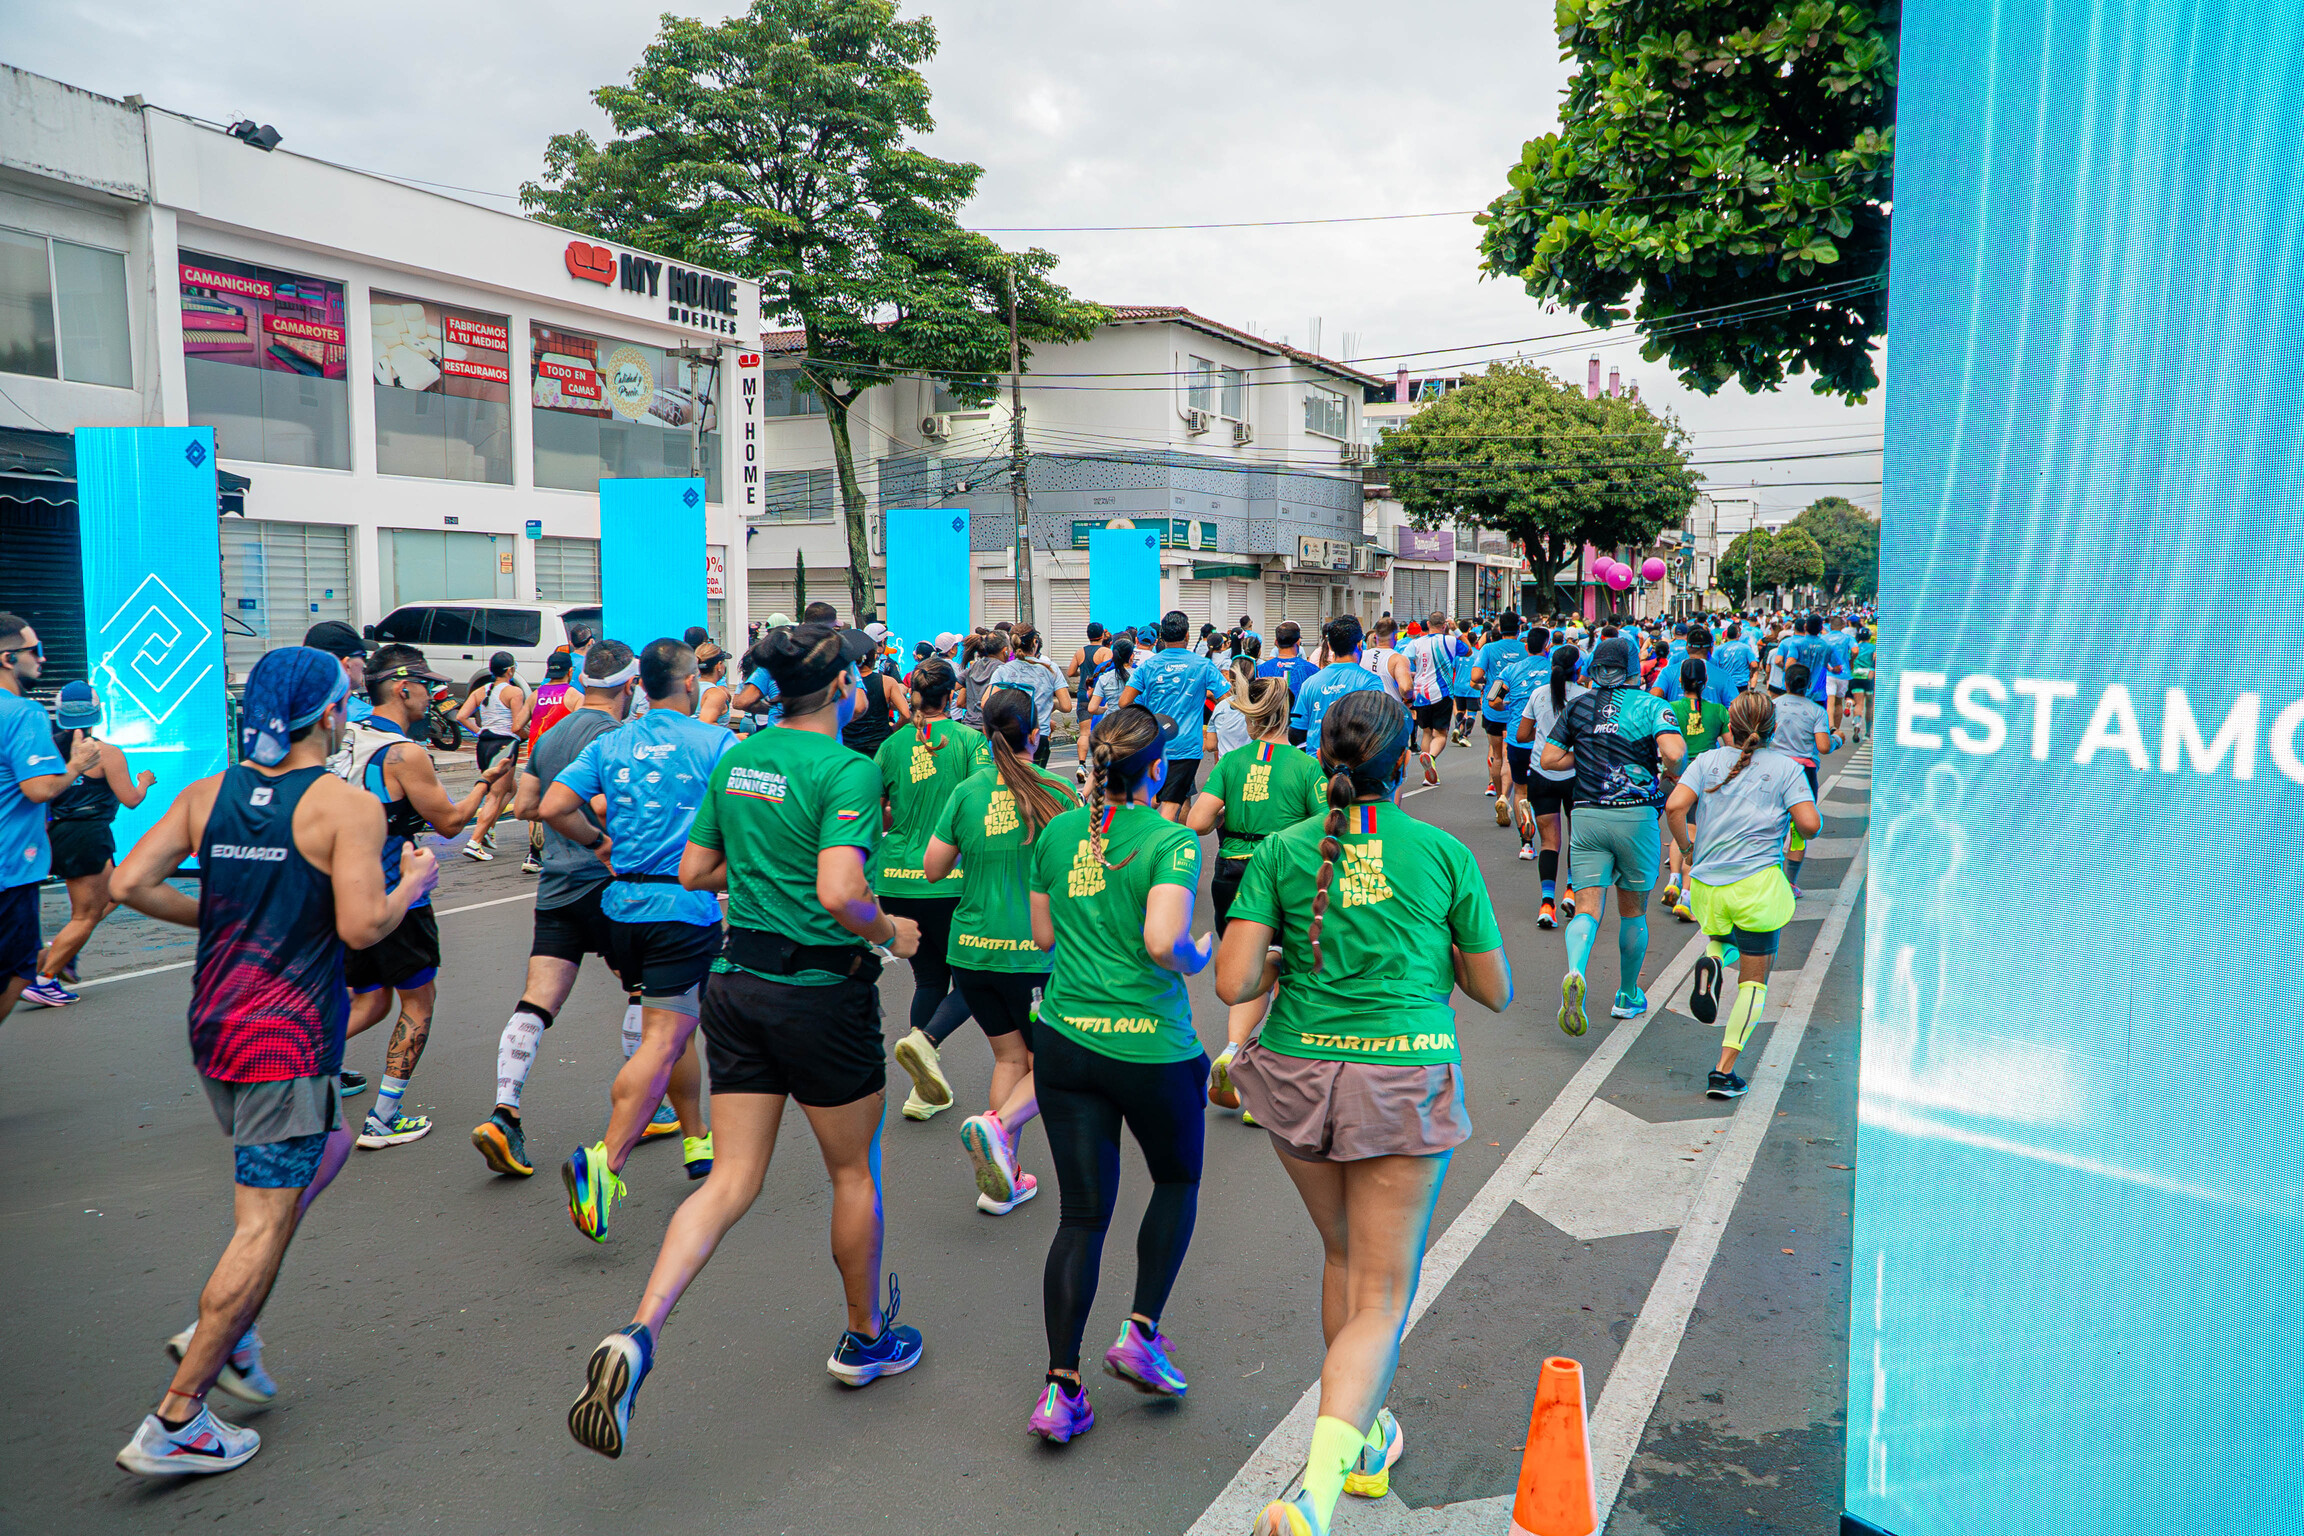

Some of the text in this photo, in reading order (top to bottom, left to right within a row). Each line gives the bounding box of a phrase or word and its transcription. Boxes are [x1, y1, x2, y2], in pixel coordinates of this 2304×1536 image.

[185, 269, 270, 297] CAMANICHOS
[621, 253, 738, 316] MY HOME
[272, 319, 340, 341] CAMAROTES
[449, 318, 507, 338] FABRICAMOS
[669, 307, 737, 335] MUEBLES
[449, 331, 507, 350] A TU MEDIDA
[444, 361, 508, 380] RESTAURAMOS
[546, 365, 586, 381] TODO EN
[568, 383, 596, 397] CAMAS
[744, 422, 758, 505] HOME
[1371, 650, 1381, 673] RUN
[1593, 723, 1620, 734] DIEGO
[730, 766, 788, 786] COLOMBIAN
[726, 776, 787, 798] RUNNERS
[210, 844, 288, 862] EDUARDO
[1113, 1017, 1159, 1034] RUN
[1412, 1032, 1455, 1052] RUN
